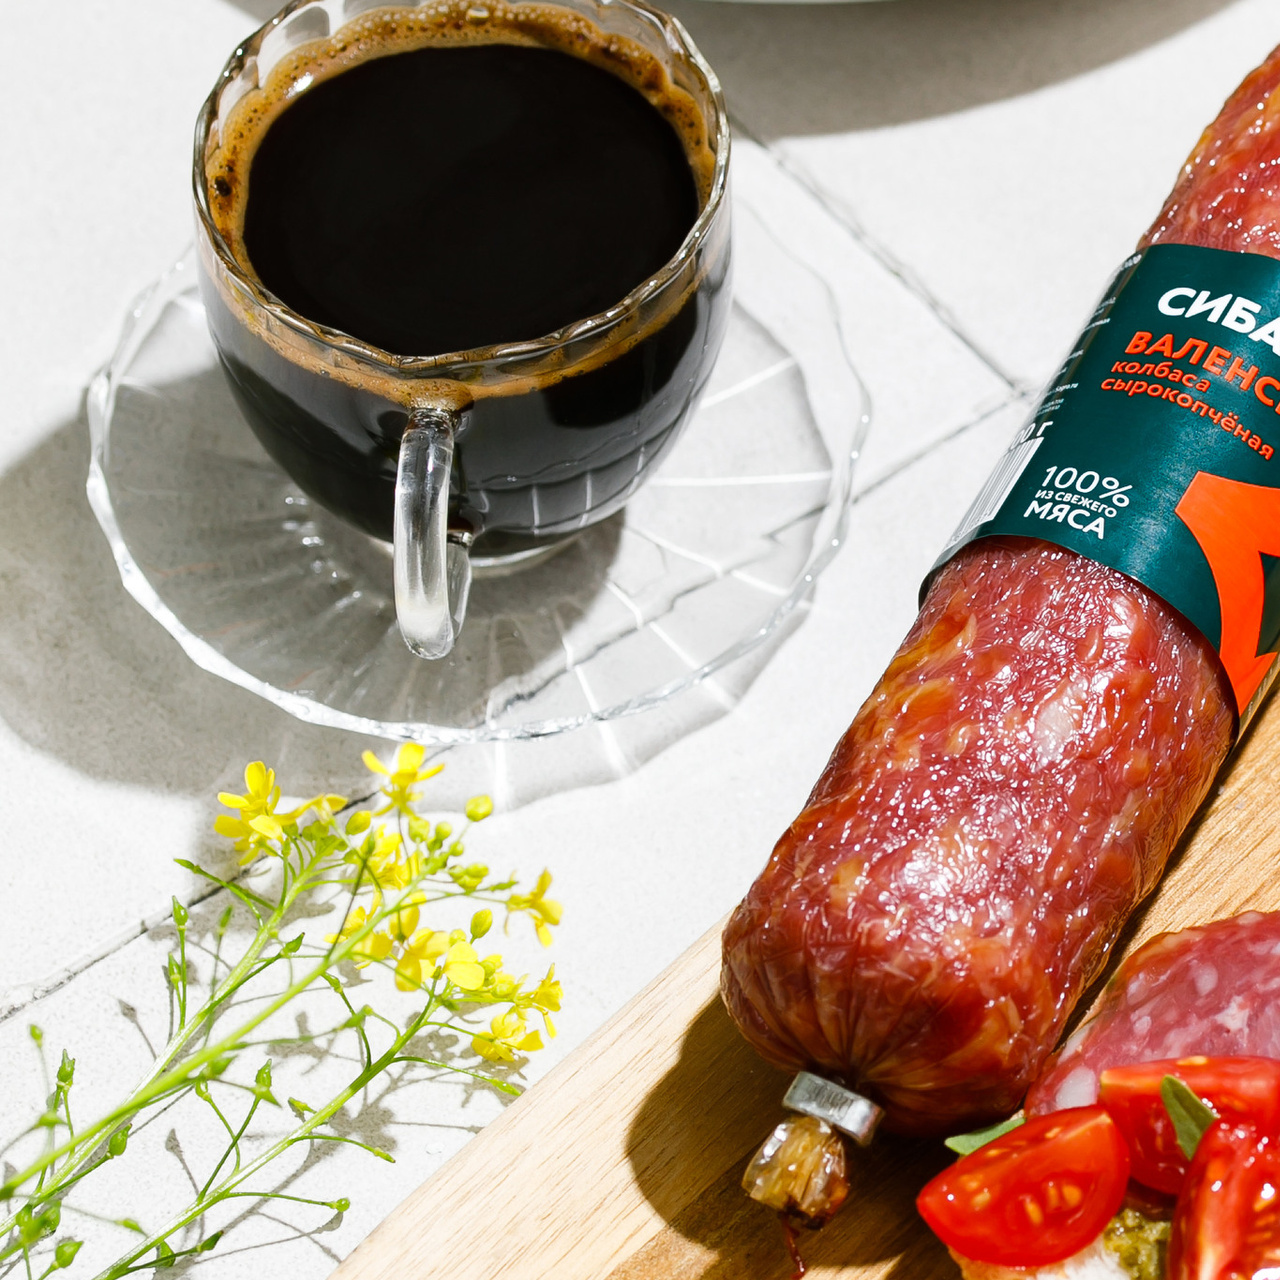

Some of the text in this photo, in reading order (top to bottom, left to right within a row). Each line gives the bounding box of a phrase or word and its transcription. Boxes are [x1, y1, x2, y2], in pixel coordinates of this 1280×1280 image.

[1110, 361, 1212, 393] колбаса
[1100, 377, 1276, 461] сырокопчёная
[1034, 489, 1118, 518] ИЗ СВЕЖЕГО
[1041, 465, 1133, 508] 100%
[1023, 500, 1105, 540] МЯСА
